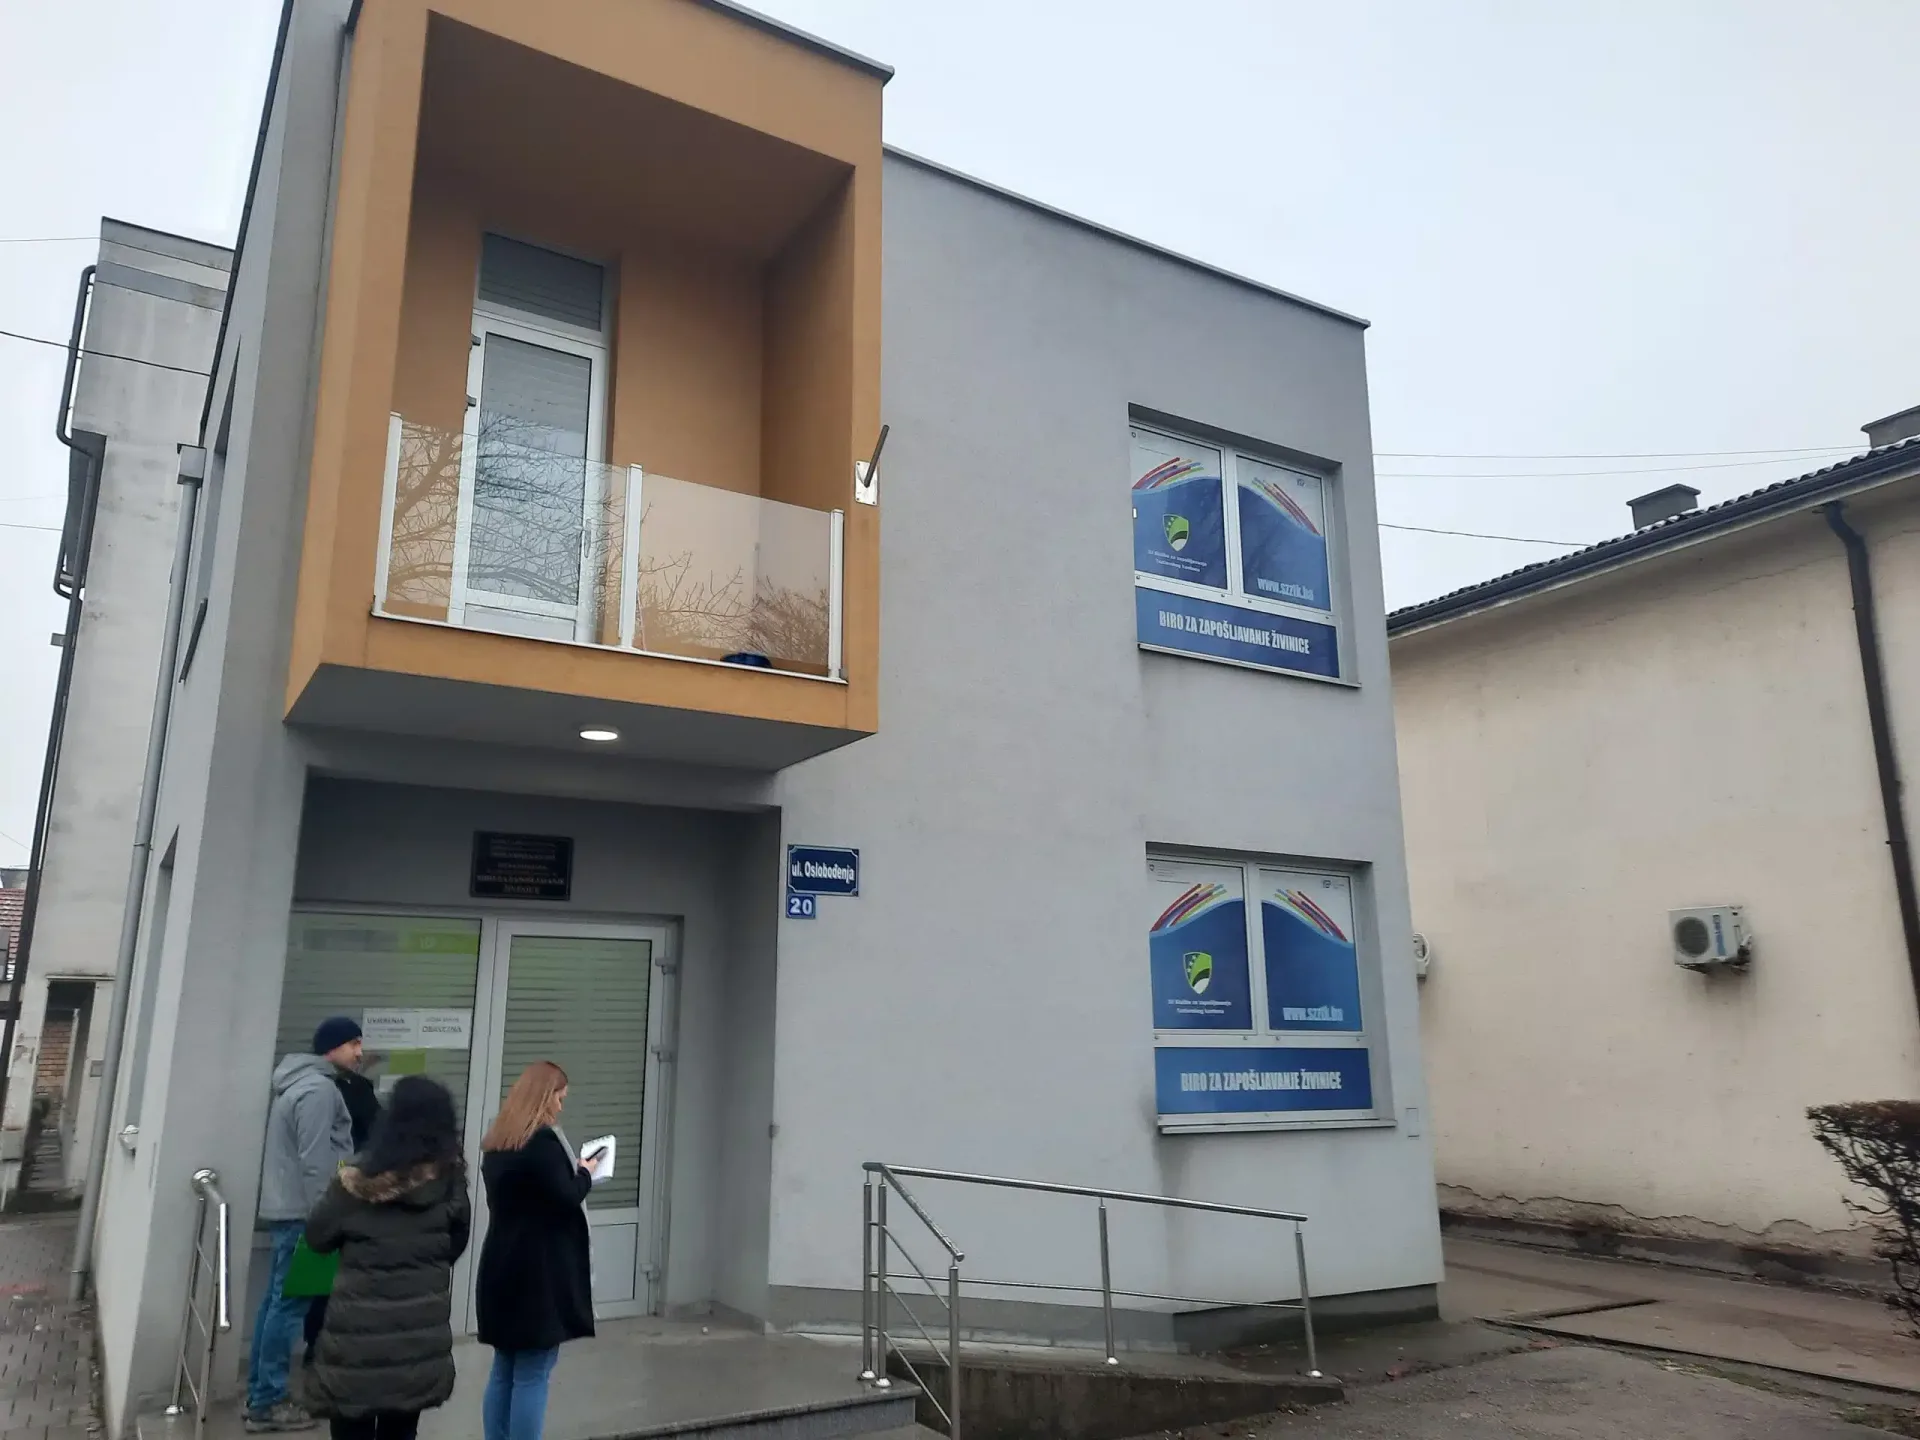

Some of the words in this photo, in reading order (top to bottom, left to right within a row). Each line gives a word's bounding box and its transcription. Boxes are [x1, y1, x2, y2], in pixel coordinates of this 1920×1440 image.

[1159, 610, 1183, 631] BIRO
[1184, 616, 1198, 634] ZA
[1198, 618, 1271, 647] ZAPOŠLJAVANJE
[1271, 630, 1310, 655] ŽIVINICE
[791, 861, 803, 877] ul.
[790, 897, 812, 915] 20
[1181, 1072, 1207, 1091] BIRO
[1208, 1071, 1223, 1091] ZA
[1223, 1068, 1300, 1091] ZAPOŠLJAVANJE
[1300, 1067, 1342, 1090] ŽIVINICE
